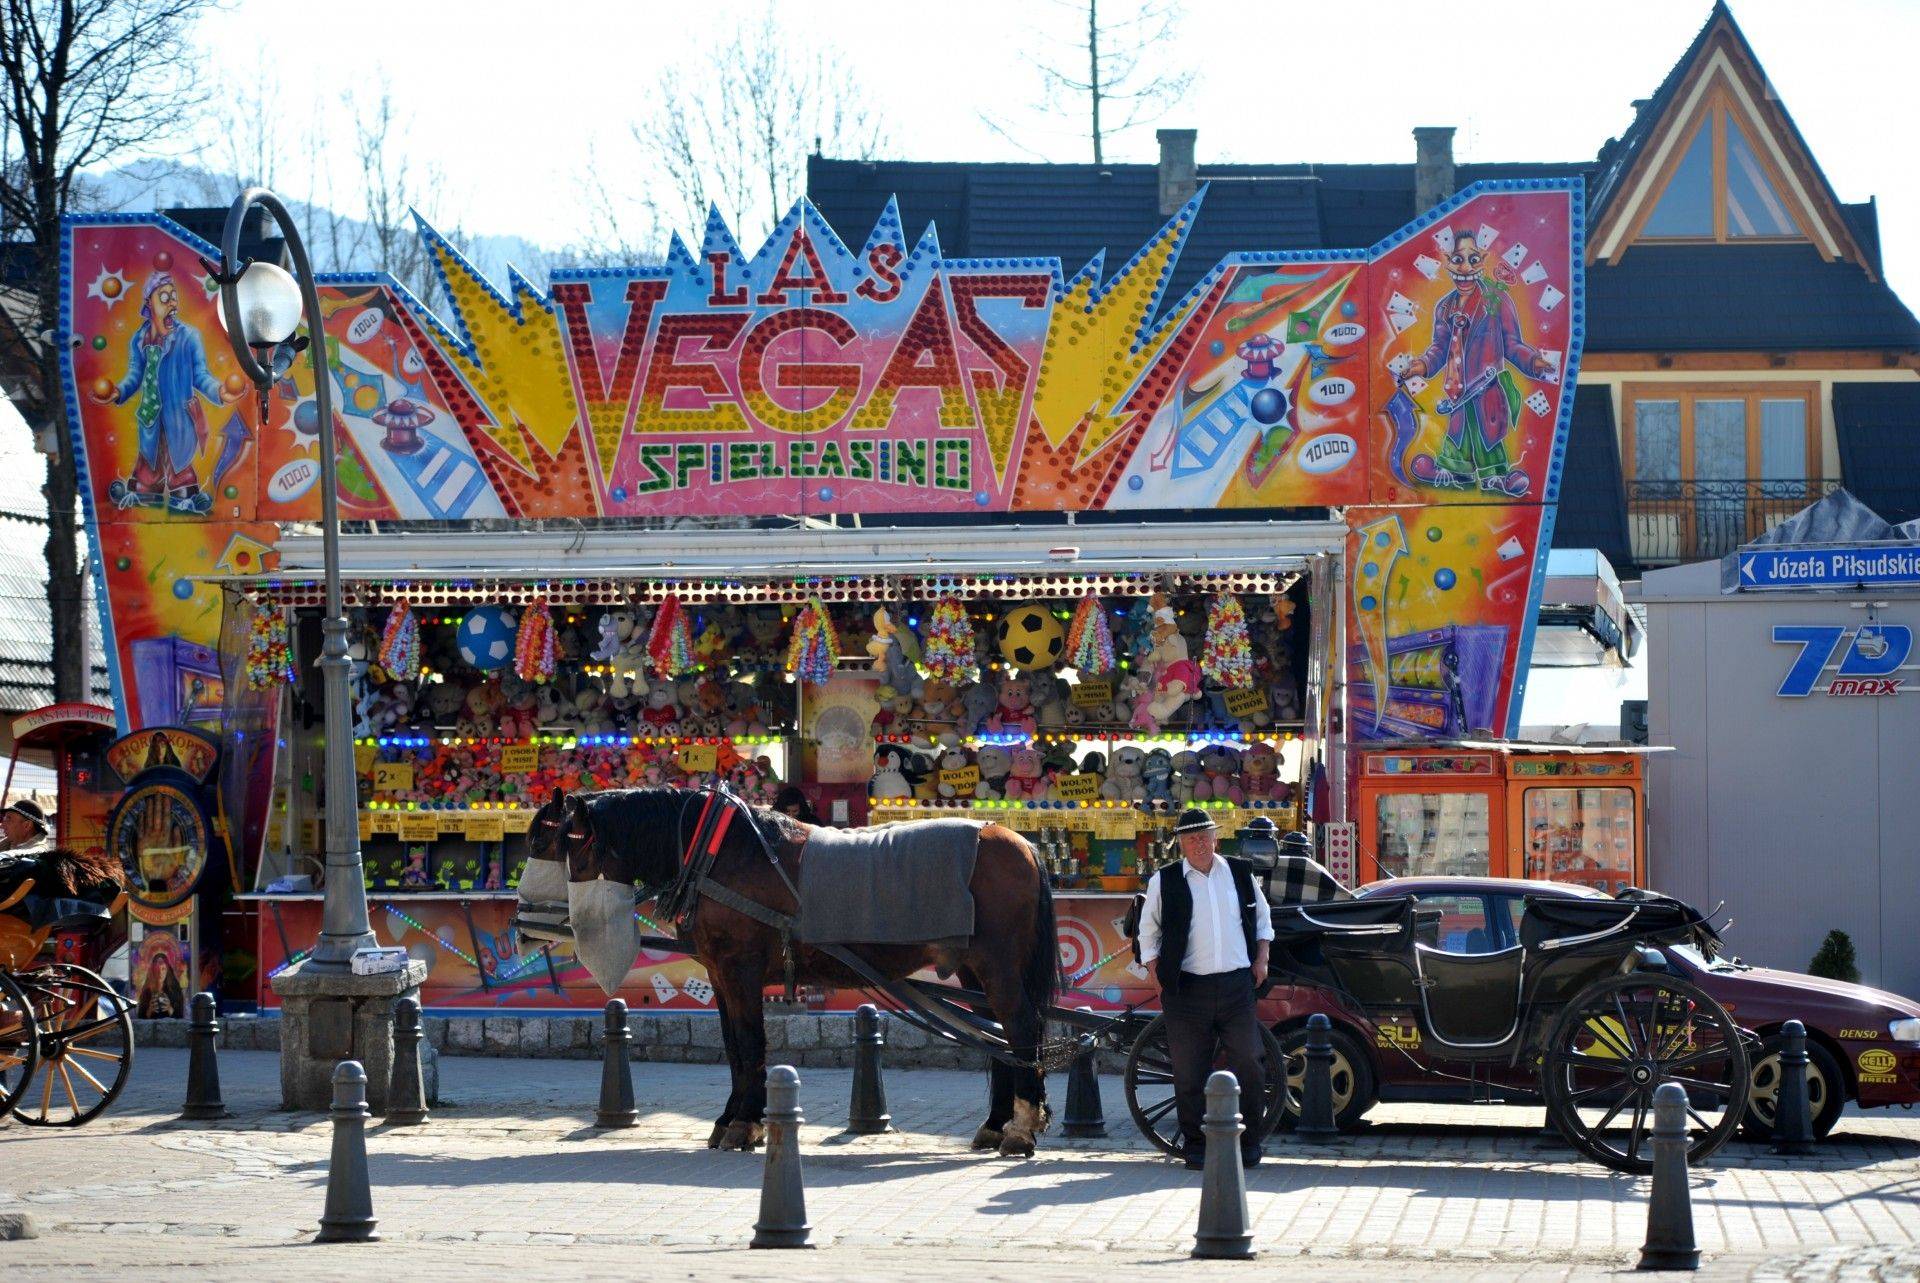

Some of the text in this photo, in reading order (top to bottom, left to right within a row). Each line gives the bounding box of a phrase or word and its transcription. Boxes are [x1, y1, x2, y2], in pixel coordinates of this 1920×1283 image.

[707, 226, 906, 306] LAS
[354, 314, 378, 337] 1000
[1331, 327, 1358, 337] 1000
[551, 271, 1054, 496] VEGAS
[1320, 383, 1346, 396] 100
[1306, 440, 1350, 463] 10000
[638, 438, 972, 494] SPIELCASINO
[278, 464, 311, 490] 1000
[1768, 556, 1825, 579] Józefa
[1772, 624, 1912, 697] 7D
[1227, 689, 1261, 704] WOLNY
[682, 750, 690, 763] 1
[378, 770, 387, 784] 2
[943, 770, 975, 780] WOLNY
[1060, 777, 1093, 787] WOLNY
[951, 780, 977, 790] YBÓR
[1377, 1024, 1422, 1043] SU
[1839, 1029, 1878, 1039] DENSO
[1861, 1056, 1897, 1067] HELLA
